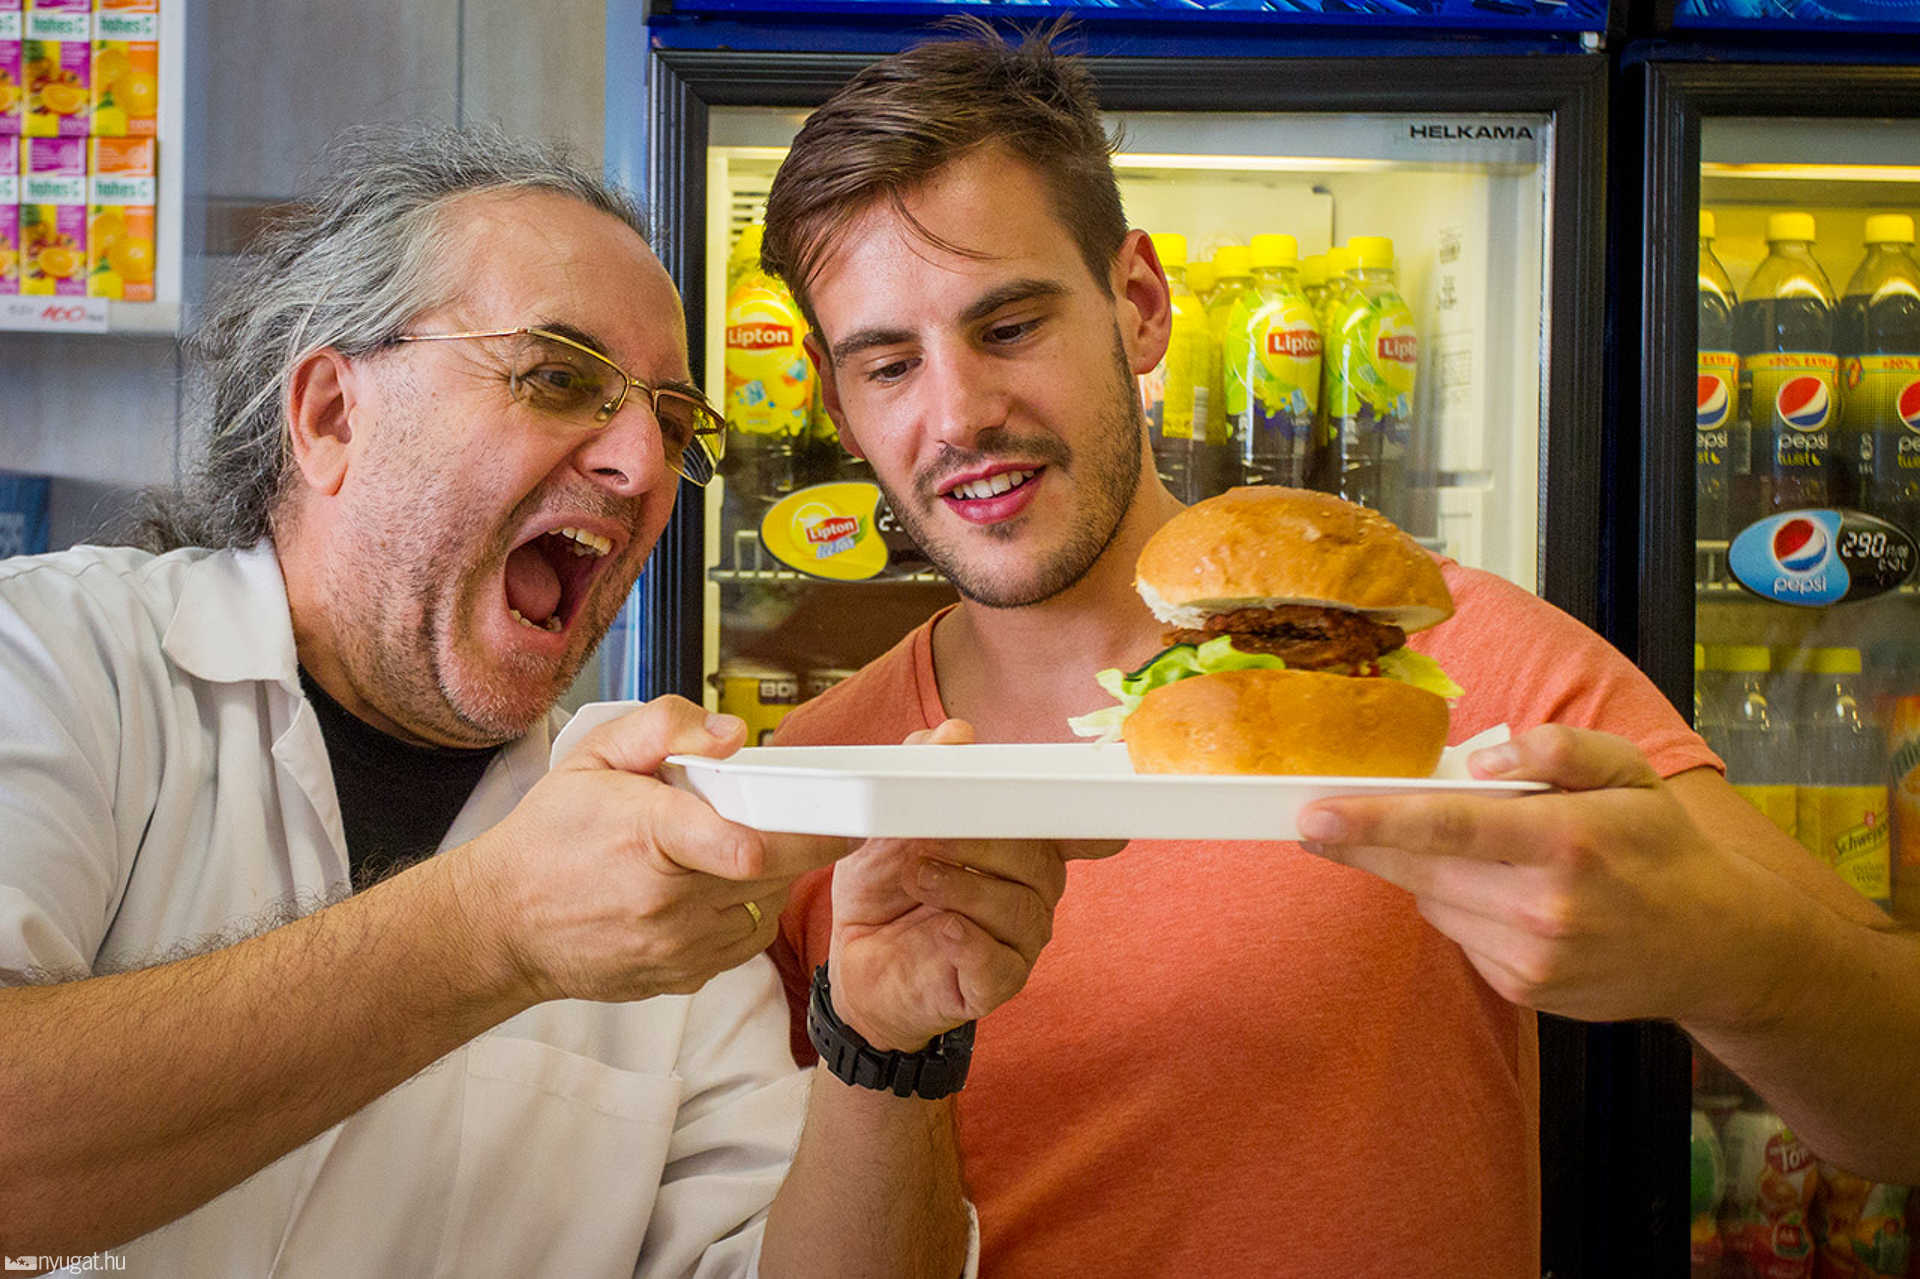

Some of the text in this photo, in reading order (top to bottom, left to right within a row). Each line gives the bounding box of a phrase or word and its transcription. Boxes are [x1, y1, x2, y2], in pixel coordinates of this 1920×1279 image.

[1410, 125, 1533, 140] HELKAMA
[728, 327, 789, 347] Lipton
[1274, 334, 1320, 356] Lipto
[1778, 431, 1828, 453] pepsi
[809, 521, 855, 541] Lipton
[1842, 531, 1887, 558] 290
[1774, 576, 1826, 595] pepsi
